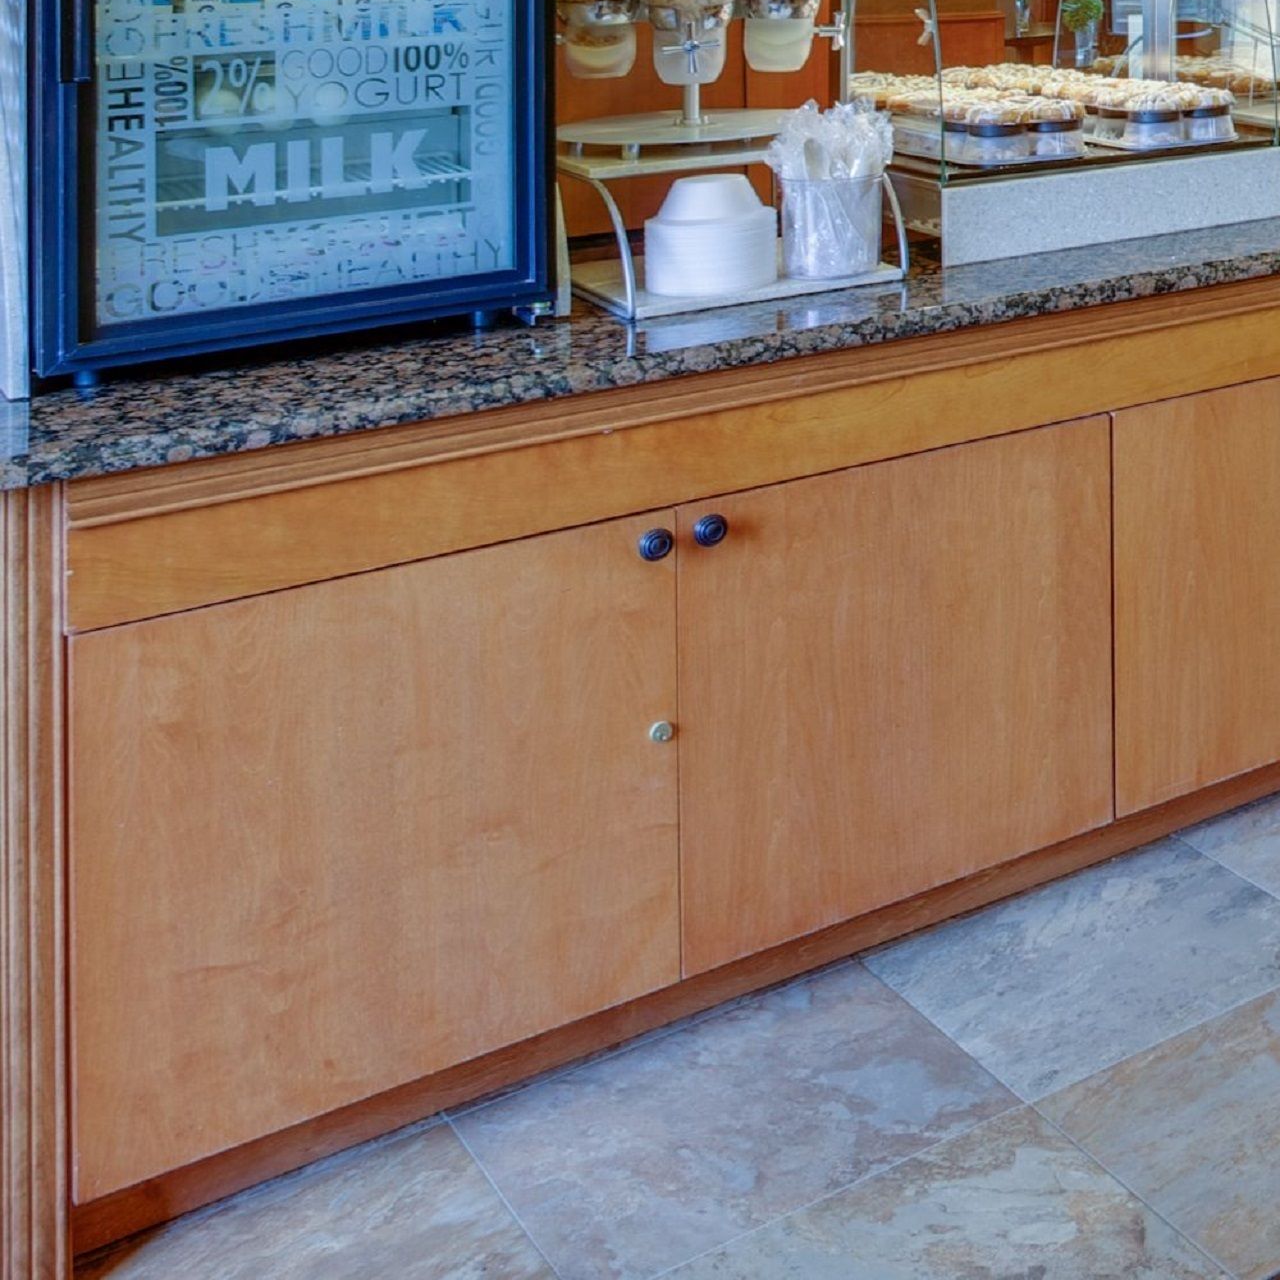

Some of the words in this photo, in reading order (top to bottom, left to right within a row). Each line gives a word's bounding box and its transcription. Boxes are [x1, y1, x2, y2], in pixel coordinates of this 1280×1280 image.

[153, 55, 189, 128] 100%
[199, 56, 277, 117] 2%
[281, 46, 388, 81] GOOD
[392, 43, 469, 73] 100%
[284, 72, 467, 114] YOGURT
[107, 86, 146, 244] HEALTHY
[205, 129, 429, 213] MILK
